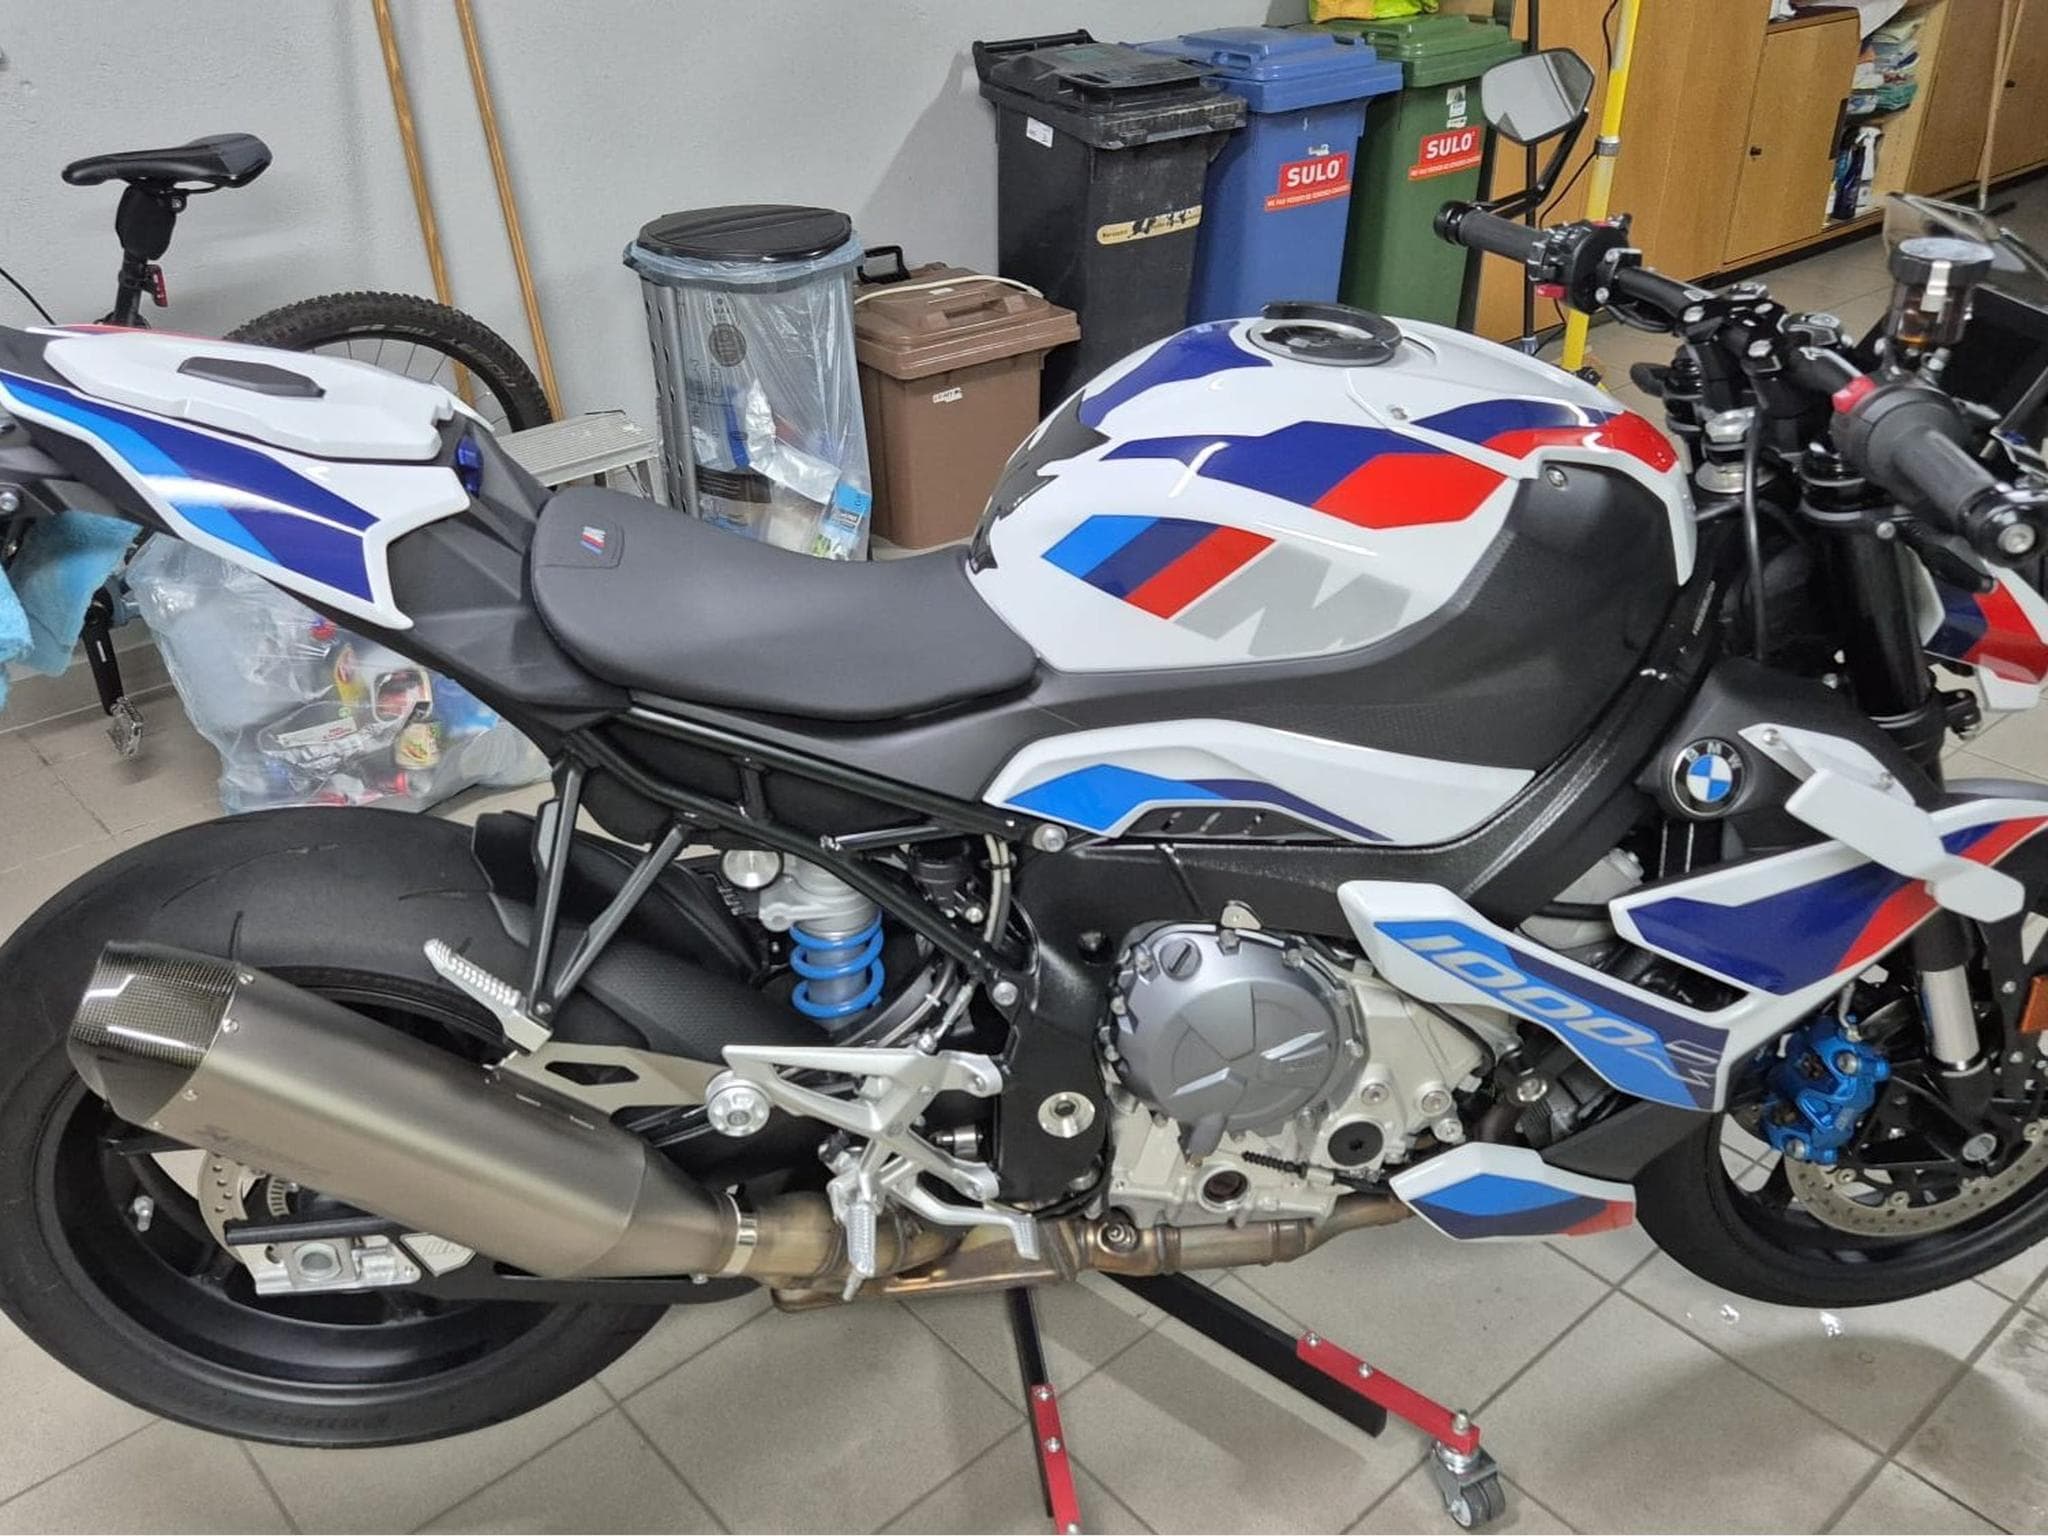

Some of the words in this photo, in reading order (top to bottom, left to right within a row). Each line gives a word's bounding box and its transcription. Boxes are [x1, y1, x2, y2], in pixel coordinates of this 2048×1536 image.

[1426, 132, 1472, 159] SULO
[1286, 159, 1340, 188] SULO
[1685, 741, 1742, 769] BMW
